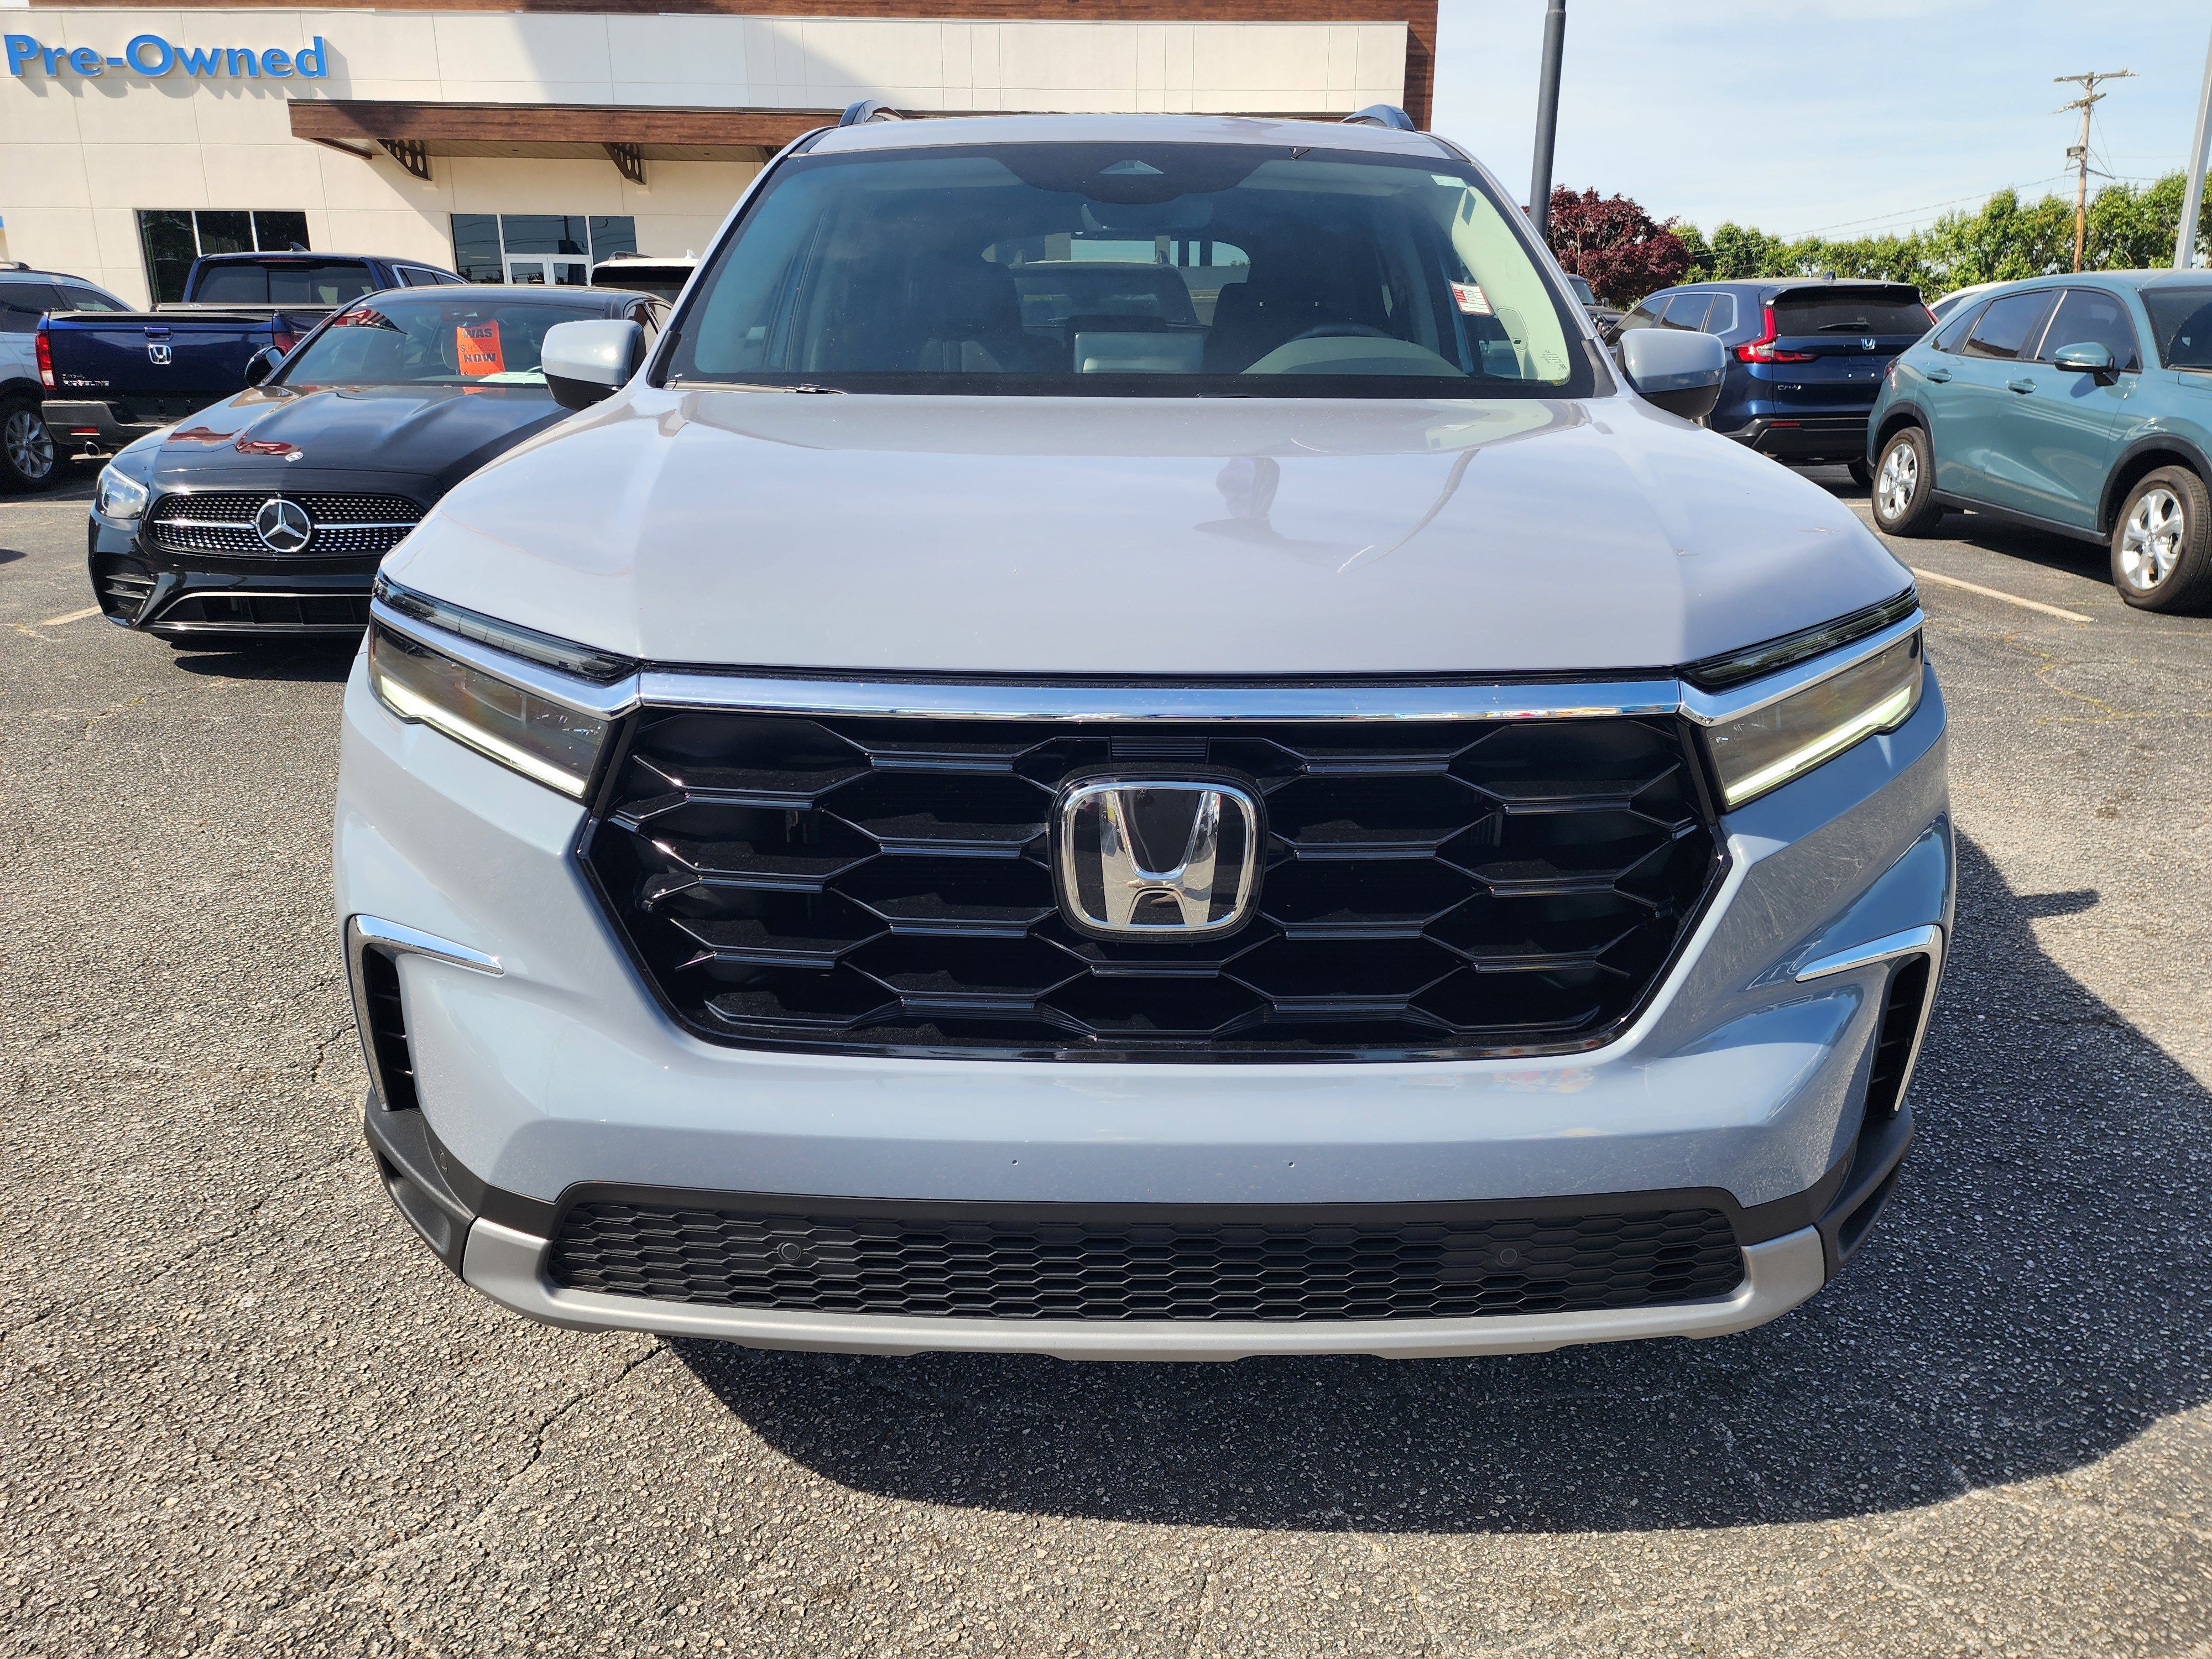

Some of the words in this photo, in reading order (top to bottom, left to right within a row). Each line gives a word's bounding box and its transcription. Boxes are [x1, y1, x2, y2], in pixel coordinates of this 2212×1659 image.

[4, 34, 328, 78] Pre-Owned
[462, 328, 493, 338] WAS
[463, 353, 496, 363] NOW
